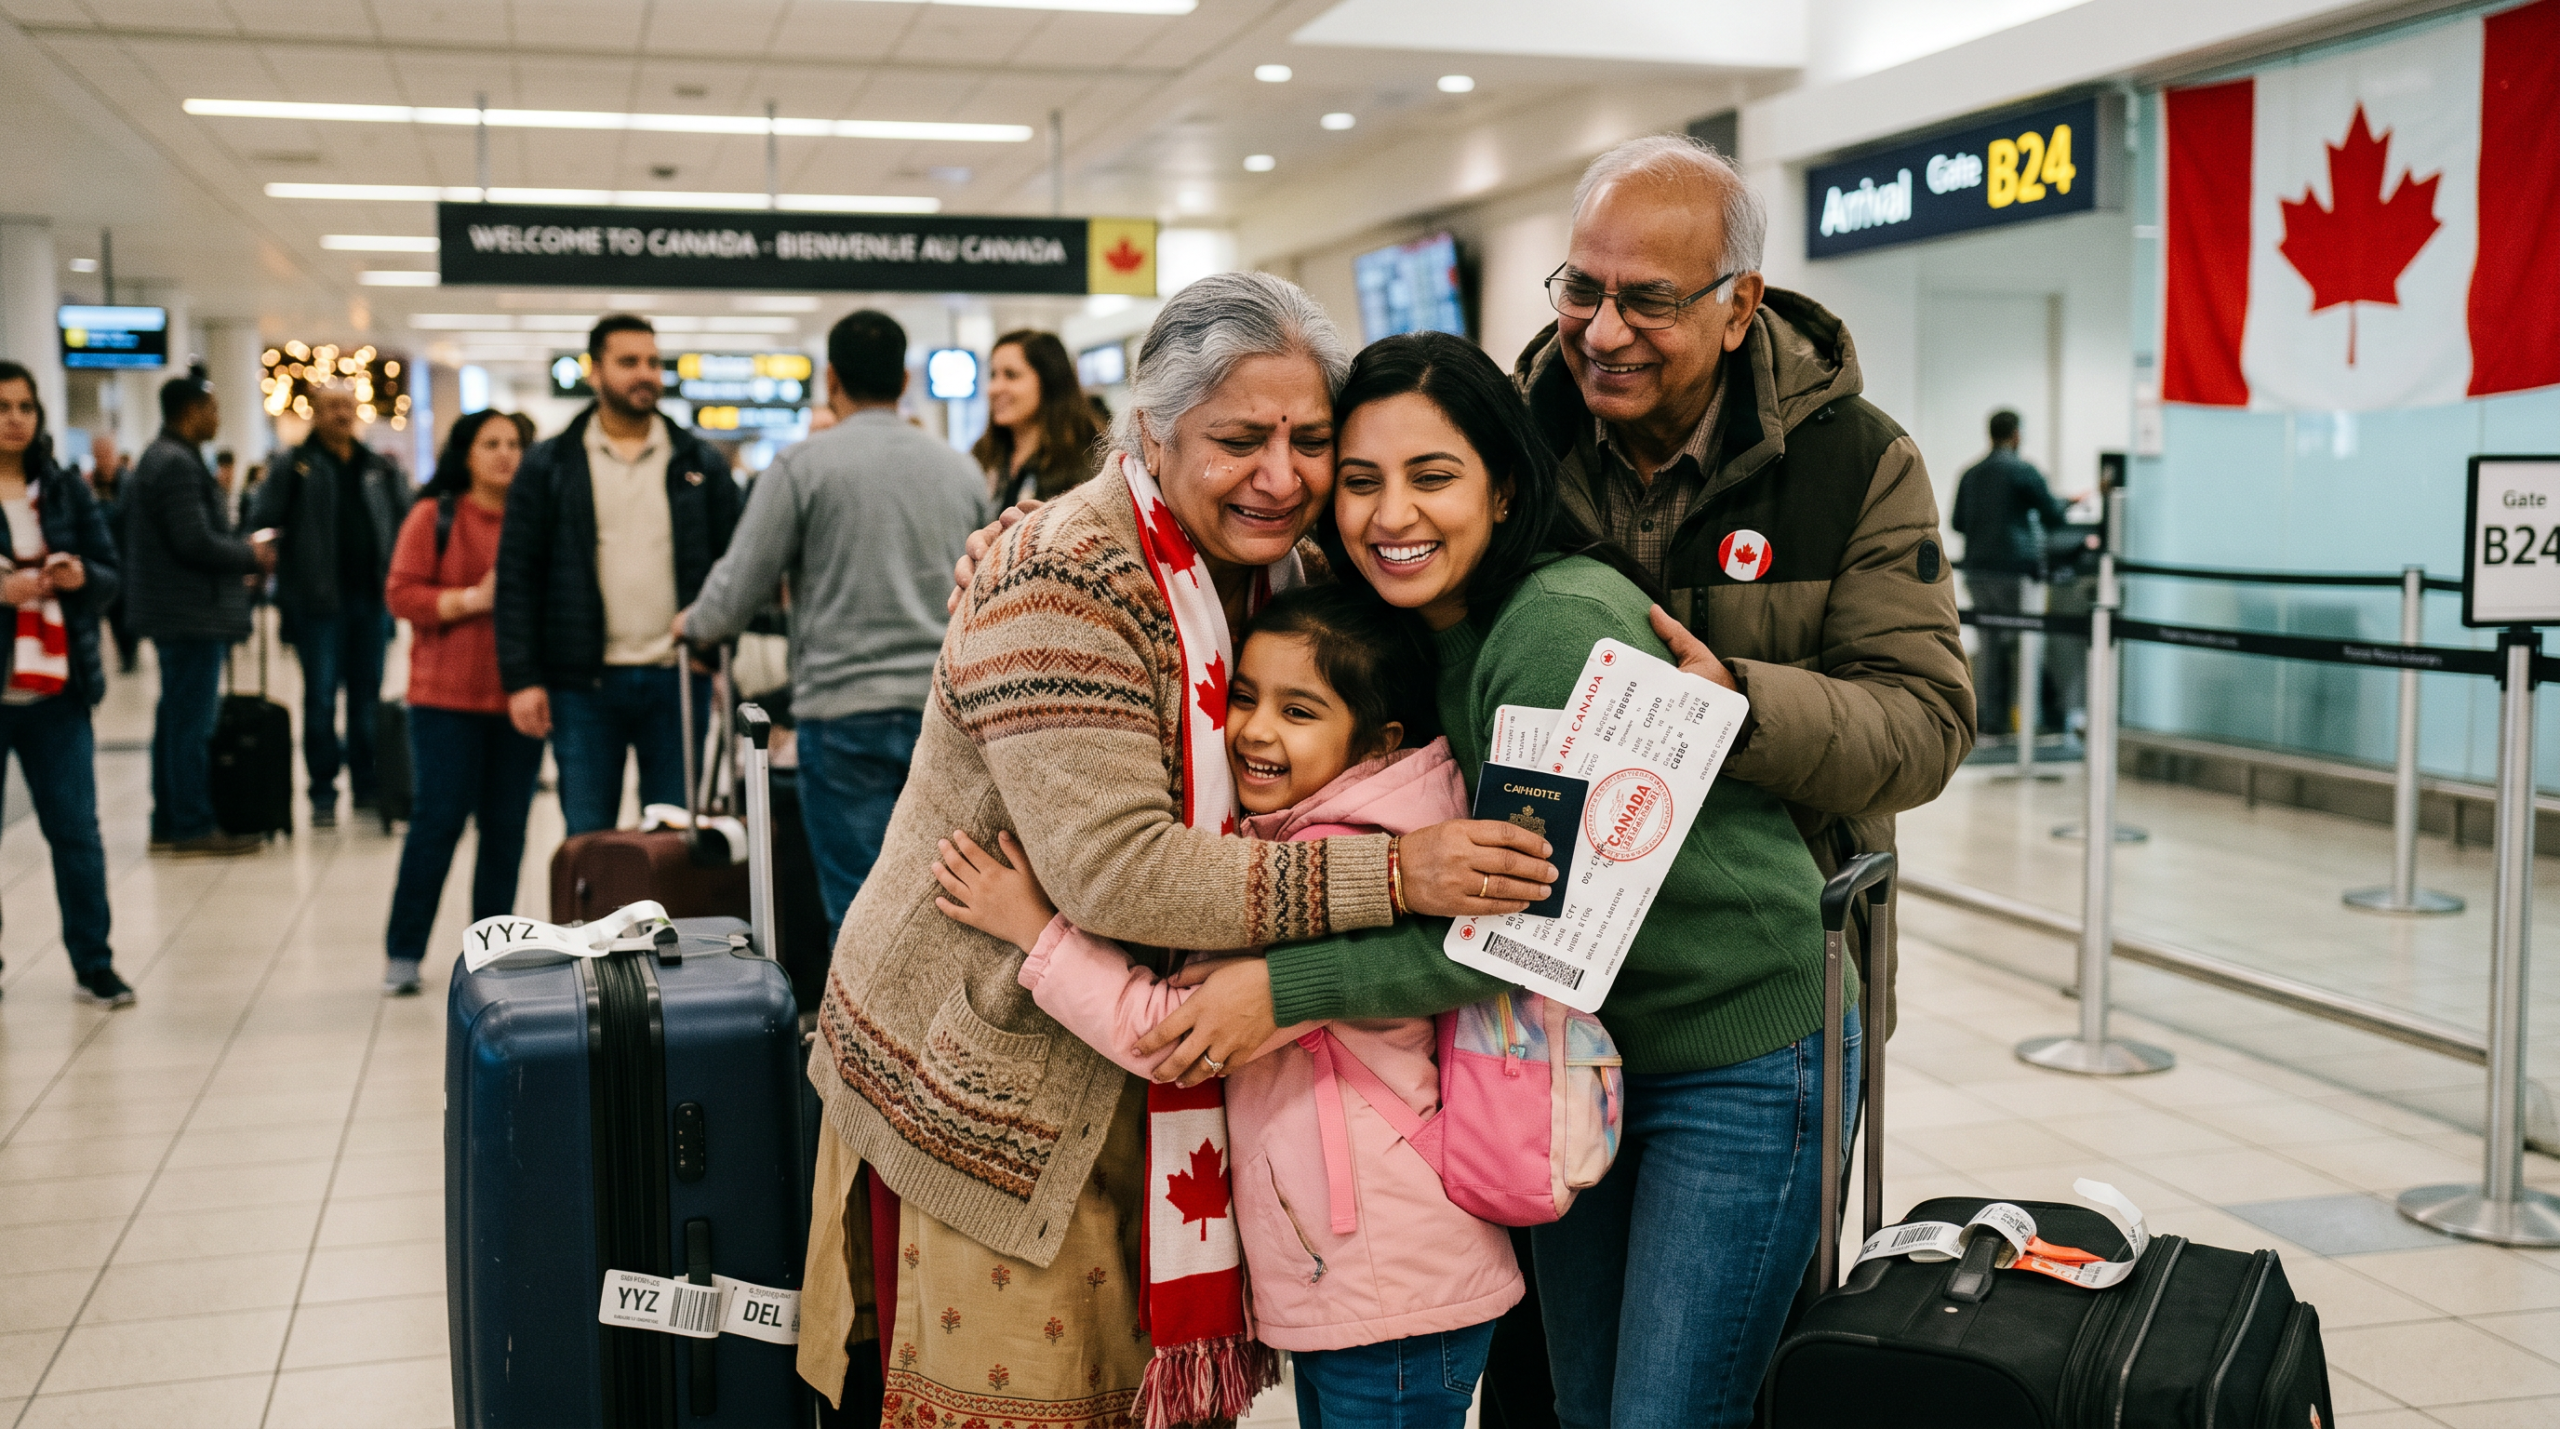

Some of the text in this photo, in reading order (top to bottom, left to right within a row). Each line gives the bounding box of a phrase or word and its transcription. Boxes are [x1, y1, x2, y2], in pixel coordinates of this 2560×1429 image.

[1820, 124, 2076, 237] Arrival Gate B24
[468, 224, 602, 255] WELCOME
[606, 227, 645, 256] TO
[647, 228, 759, 258] CANADA
[775, 231, 918, 262] BIENVENUE
[920, 234, 959, 263] AU
[961, 235, 1067, 265] CANADA
[2502, 490, 2547, 508] Gate
[1558, 735, 1576, 759] AIR
[1570, 675, 1604, 732] CANADA
[1606, 784, 1652, 847] CANADA
[475, 922, 538, 951] YYZ
[618, 1286, 660, 1314] YYZ
[742, 1300, 782, 1328] DEL
